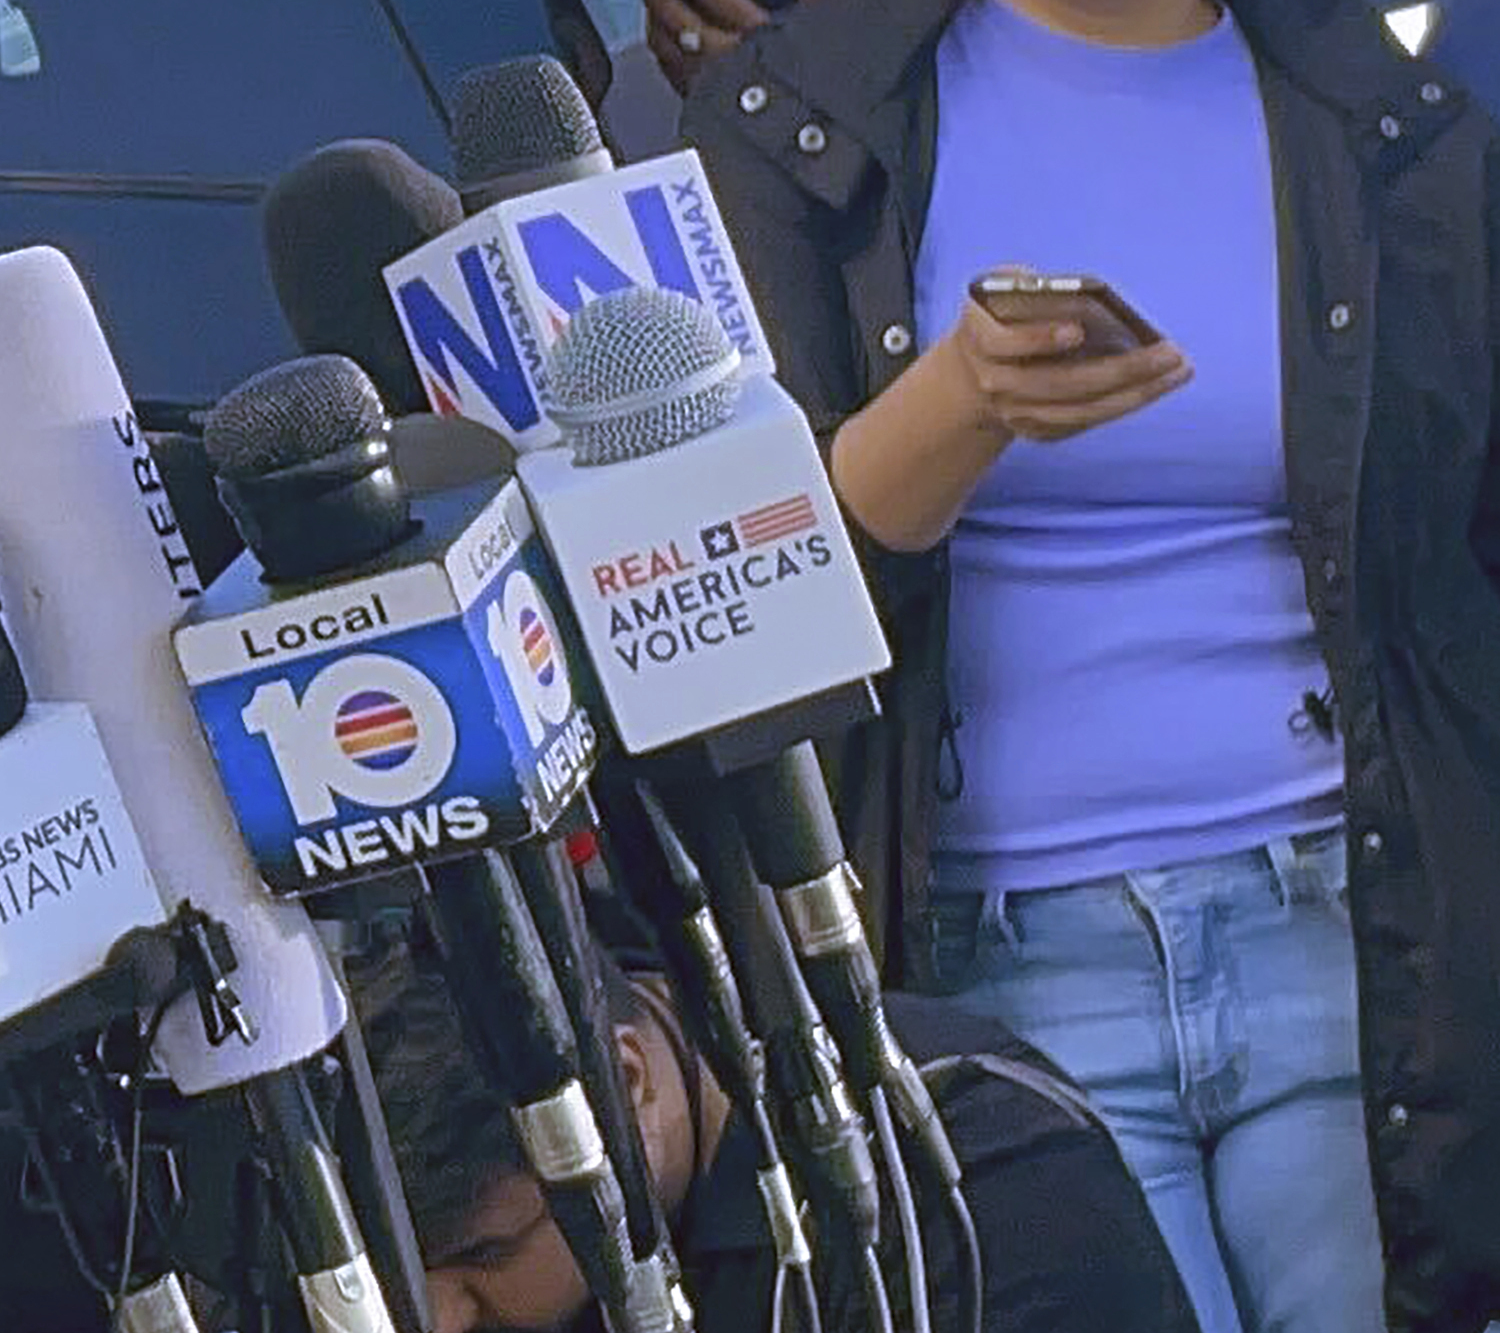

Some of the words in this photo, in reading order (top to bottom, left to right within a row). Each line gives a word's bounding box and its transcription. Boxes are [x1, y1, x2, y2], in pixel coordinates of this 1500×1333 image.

[671, 177, 757, 356] NEWSMAX
[483, 236, 553, 405] EWSMAX
[593, 540, 695, 597] REAL
[609, 535, 832, 639] AMERICA'S
[240, 593, 390, 659] Local
[615, 601, 755, 673] VOICE
[241, 653, 457, 826] 10
[21, 798, 100, 855] NEWS
[294, 796, 490, 877] NEWS
